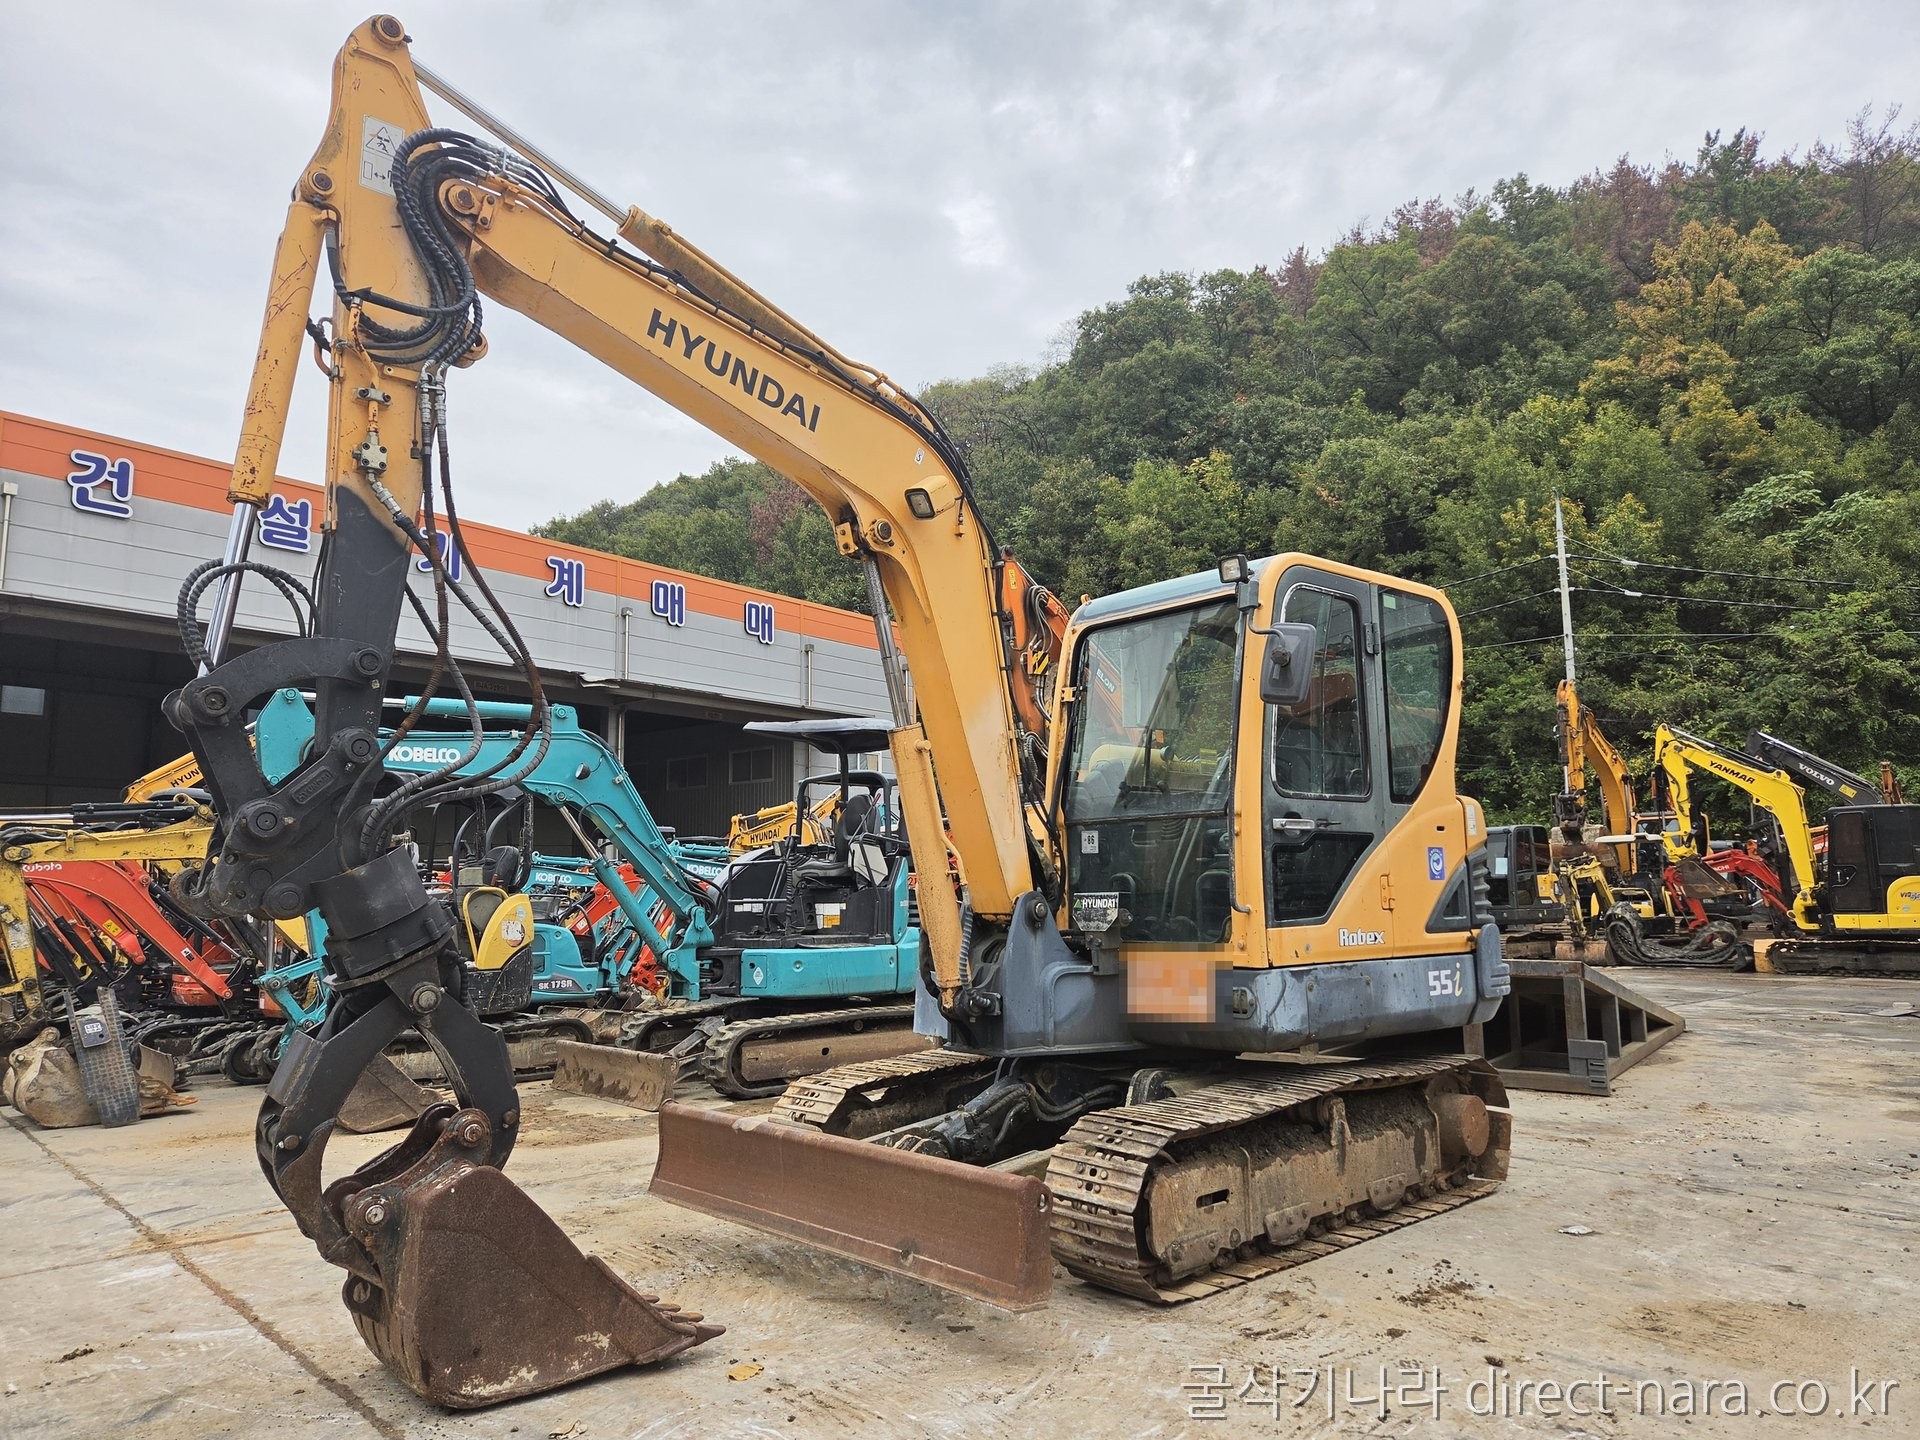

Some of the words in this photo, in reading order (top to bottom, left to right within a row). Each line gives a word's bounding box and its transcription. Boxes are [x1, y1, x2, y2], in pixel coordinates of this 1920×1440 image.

[647, 308, 821, 433] HYUNDAI
[68, 449, 134, 518] 건
[257, 494, 312, 552] 설
[545, 556, 585, 607] 계
[652, 580, 686, 627] 매
[746, 601, 775, 645] 매
[388, 745, 461, 764] KOBELCO
[1708, 760, 1756, 784] YANMAR
[1799, 763, 1835, 786] VOLVO
[750, 828, 780, 844] HYUNDAI
[686, 863, 722, 877] KOBELCO
[1082, 898, 1116, 909] HYUNDAI
[1339, 928, 1385, 946] Robex
[538, 982, 549, 990] SK
[550, 979, 573, 989] 17SR
[1428, 962, 1463, 997] 55i
